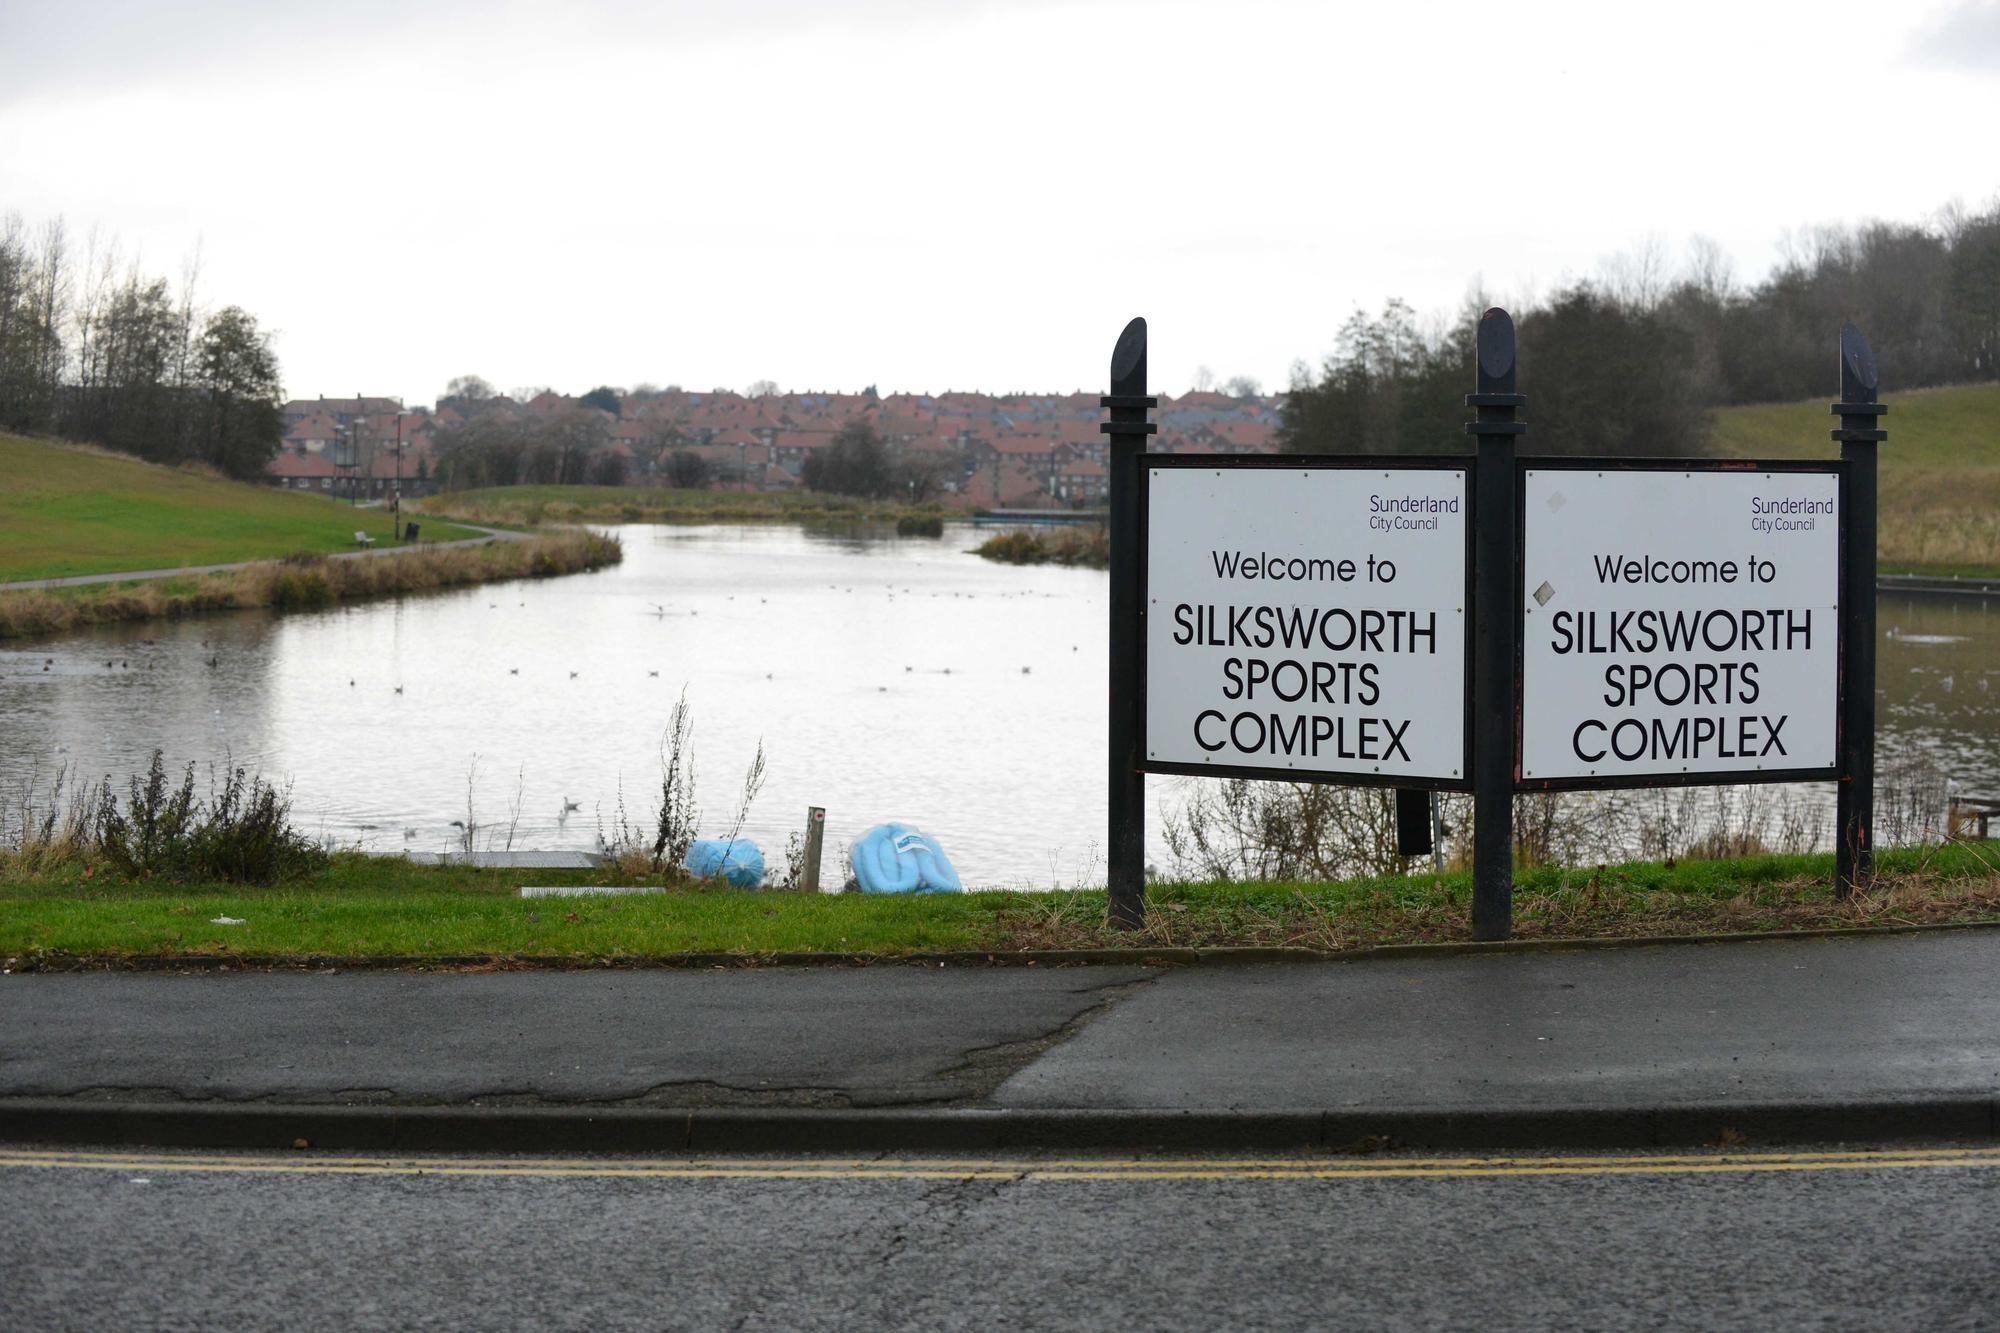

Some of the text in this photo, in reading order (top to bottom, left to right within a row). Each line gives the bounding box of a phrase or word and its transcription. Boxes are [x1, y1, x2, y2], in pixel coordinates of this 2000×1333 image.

[1370, 495, 1458, 513] Sunderland
[1752, 497, 1833, 514] Sunderland
[1370, 516, 1437, 532] City Council
[1752, 518, 1814, 533] City Council
[1212, 551, 1396, 583] Welcome to
[1594, 555, 1775, 583] Welcome to
[1173, 604, 1435, 654] SILKSWORTH
[1551, 609, 1811, 654] SILKSWORTH
[1223, 658, 1379, 706] SPORTS
[1604, 662, 1759, 707] SPORTS
[1194, 710, 1411, 762] COMPLEX
[1573, 715, 1788, 762] COMPLEX
